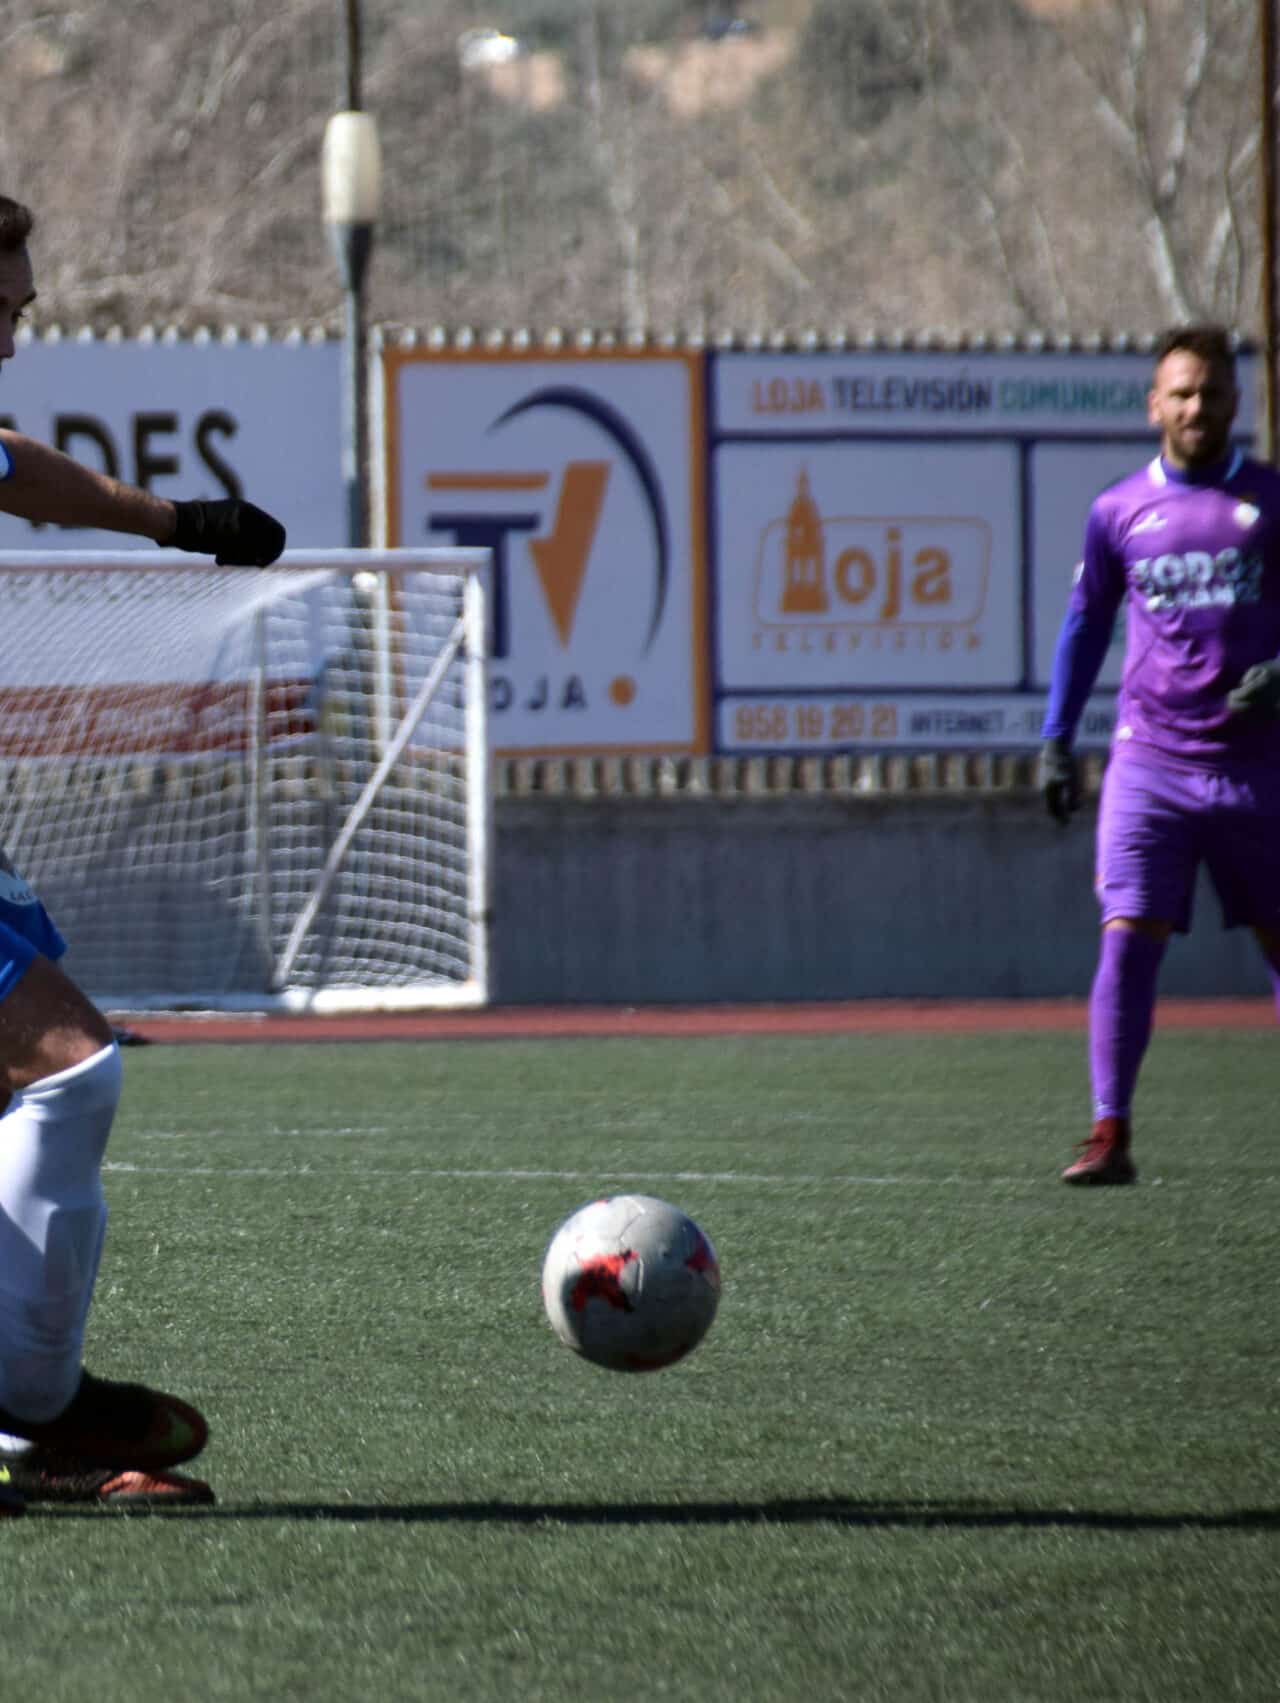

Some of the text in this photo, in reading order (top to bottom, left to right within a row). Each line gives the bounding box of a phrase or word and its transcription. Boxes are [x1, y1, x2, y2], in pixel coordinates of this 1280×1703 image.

[752, 366, 1154, 415] LOJA TELEVISIÓN COMUNICA
